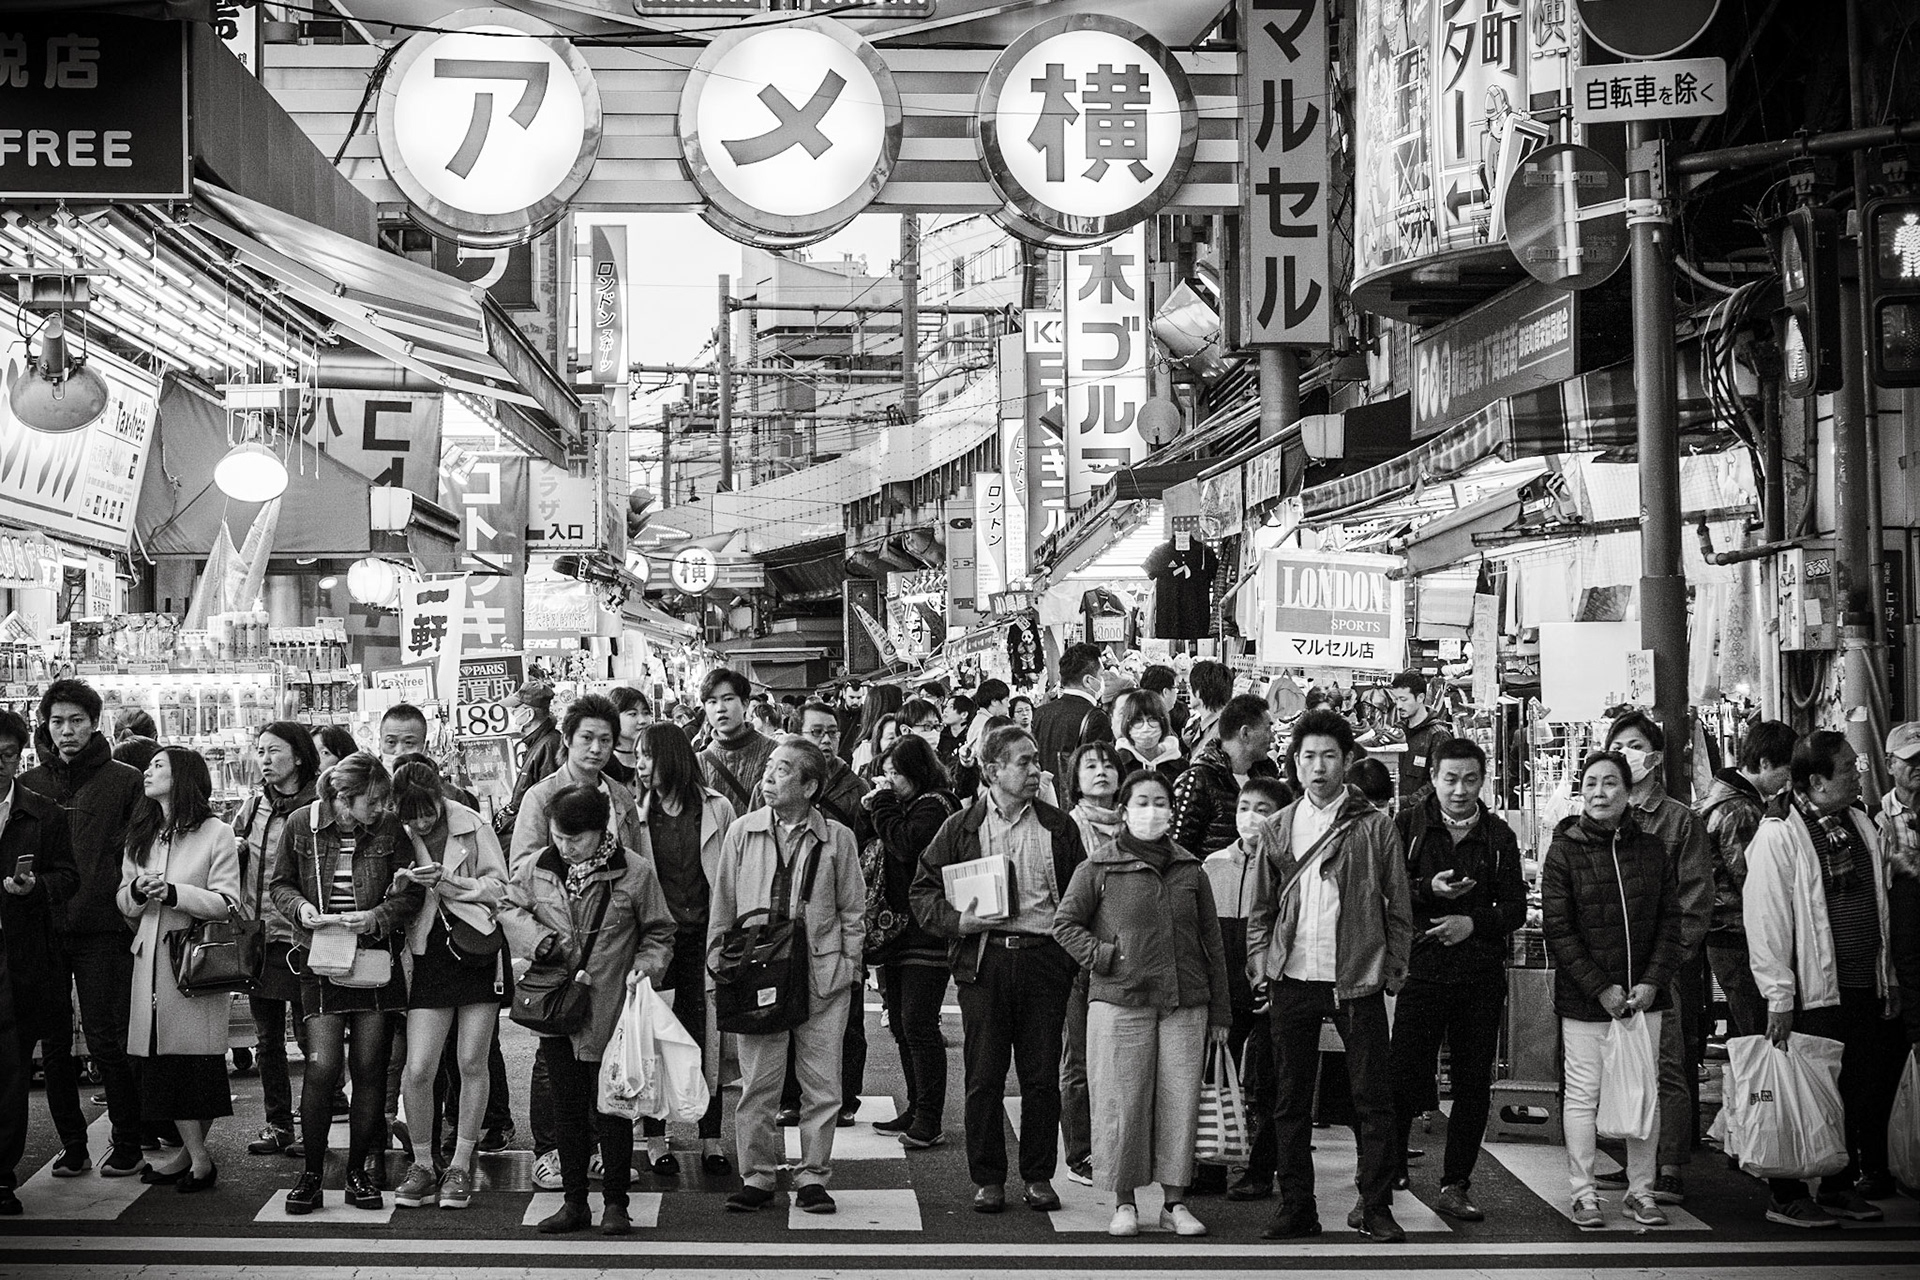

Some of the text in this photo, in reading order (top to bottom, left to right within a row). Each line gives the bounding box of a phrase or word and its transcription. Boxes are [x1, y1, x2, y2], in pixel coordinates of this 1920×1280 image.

[1441, 0, 1478, 160] ター
[1586, 71, 1714, 110] 自転車を除く
[0, 130, 133, 167] FREE
[1252, 0, 1323, 331] マルセル
[597, 262, 616, 372] ロンドン スポーツ
[548, 523, 585, 541] 入口
[679, 556, 708, 584] 横
[1281, 565, 1390, 613] LONDON
[407, 588, 450, 657] 一軒
[1331, 617, 1381, 633] SPORTS
[1291, 638, 1375, 659] マルセル店
[472, 663, 505, 677] PARIS
